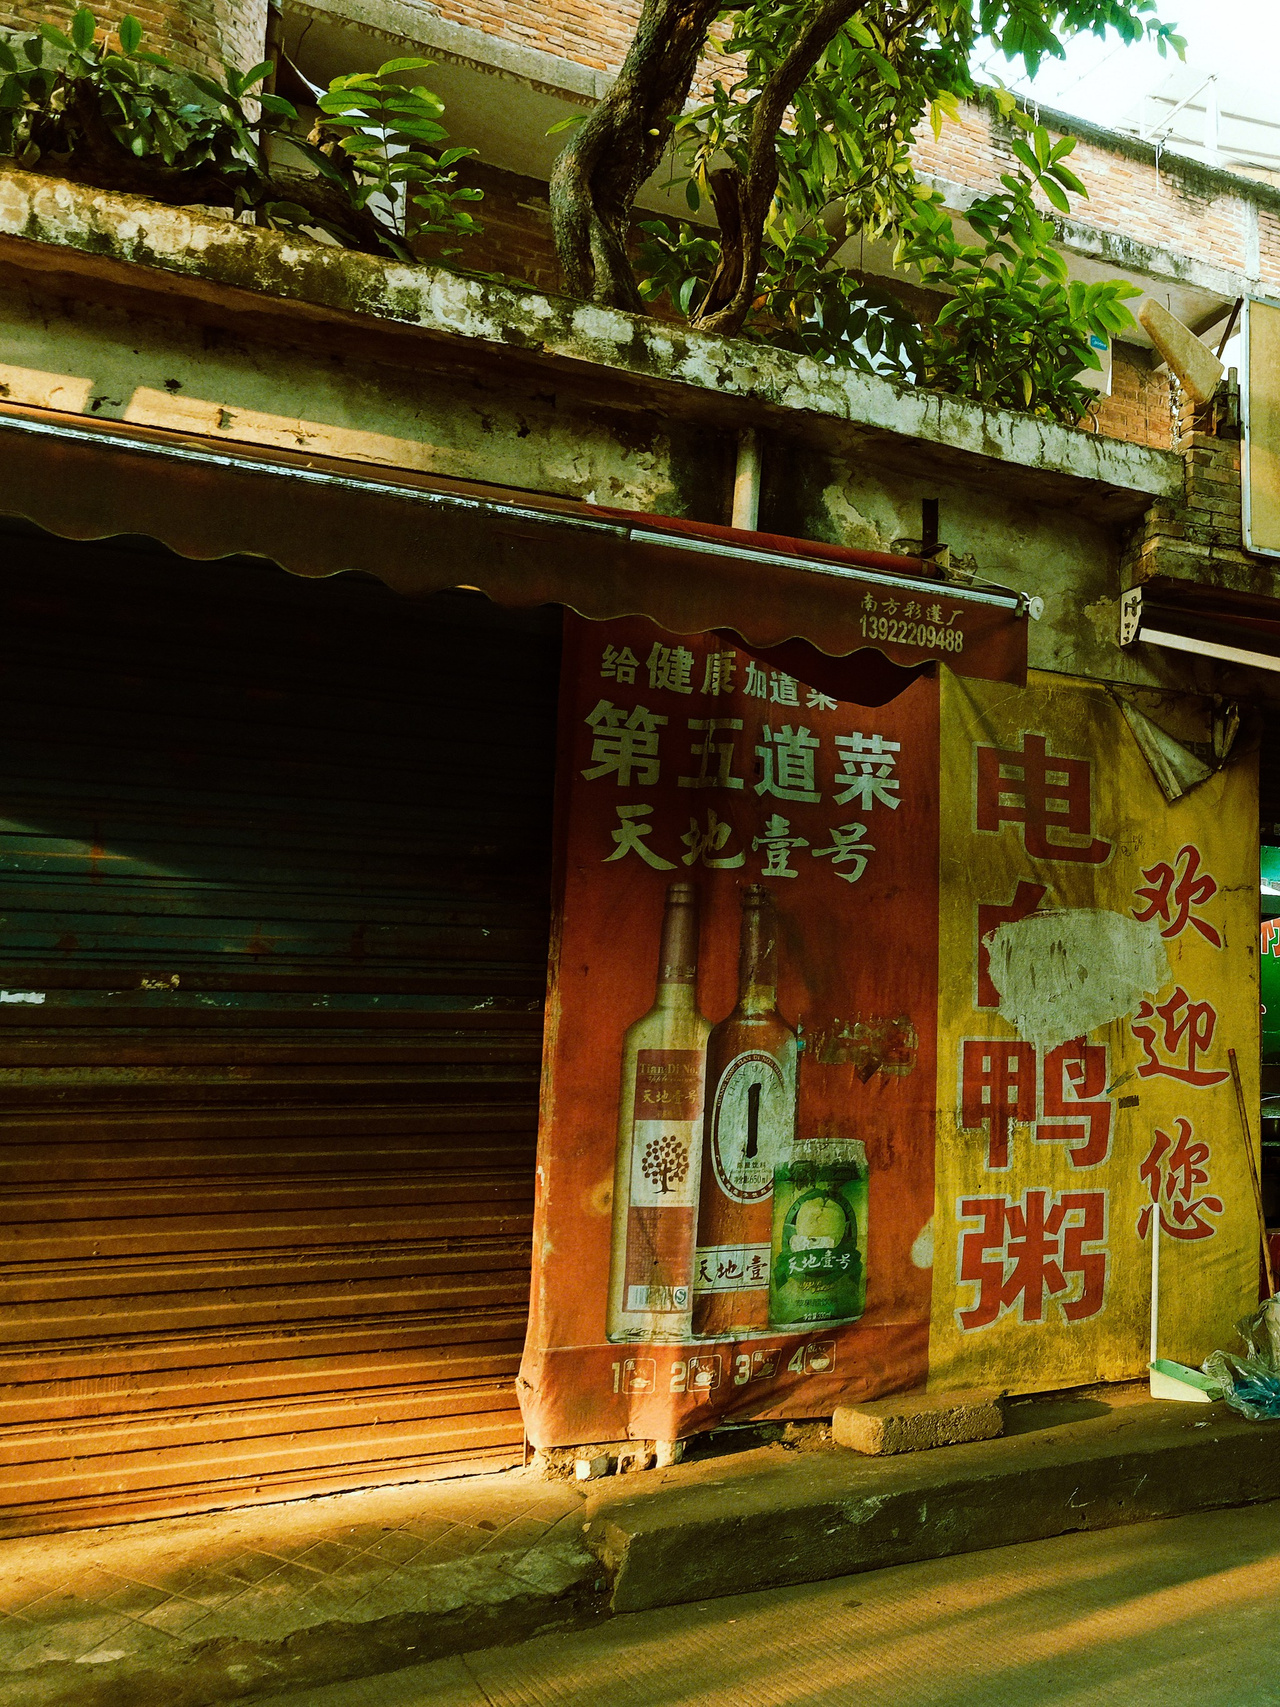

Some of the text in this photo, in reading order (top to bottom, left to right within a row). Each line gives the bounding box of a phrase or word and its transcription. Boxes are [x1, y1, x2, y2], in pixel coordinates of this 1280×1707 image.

[859, 614, 964, 653] 13922209488
[580, 698, 905, 811] 第五道菜
[601, 803, 876, 883] 天地壹号
[959, 731, 1116, 1330] 电鸭粥
[1131, 845, 1230, 1238] 欢迎您
[642, 1089, 699, 1106] 天地壹号
[788, 1249, 851, 1275] 天地壹号
[734, 1354, 751, 1385] 3
[788, 1346, 805, 1374] 4
[611, 1362, 620, 1394] 1
[670, 1361, 687, 1393] 2
